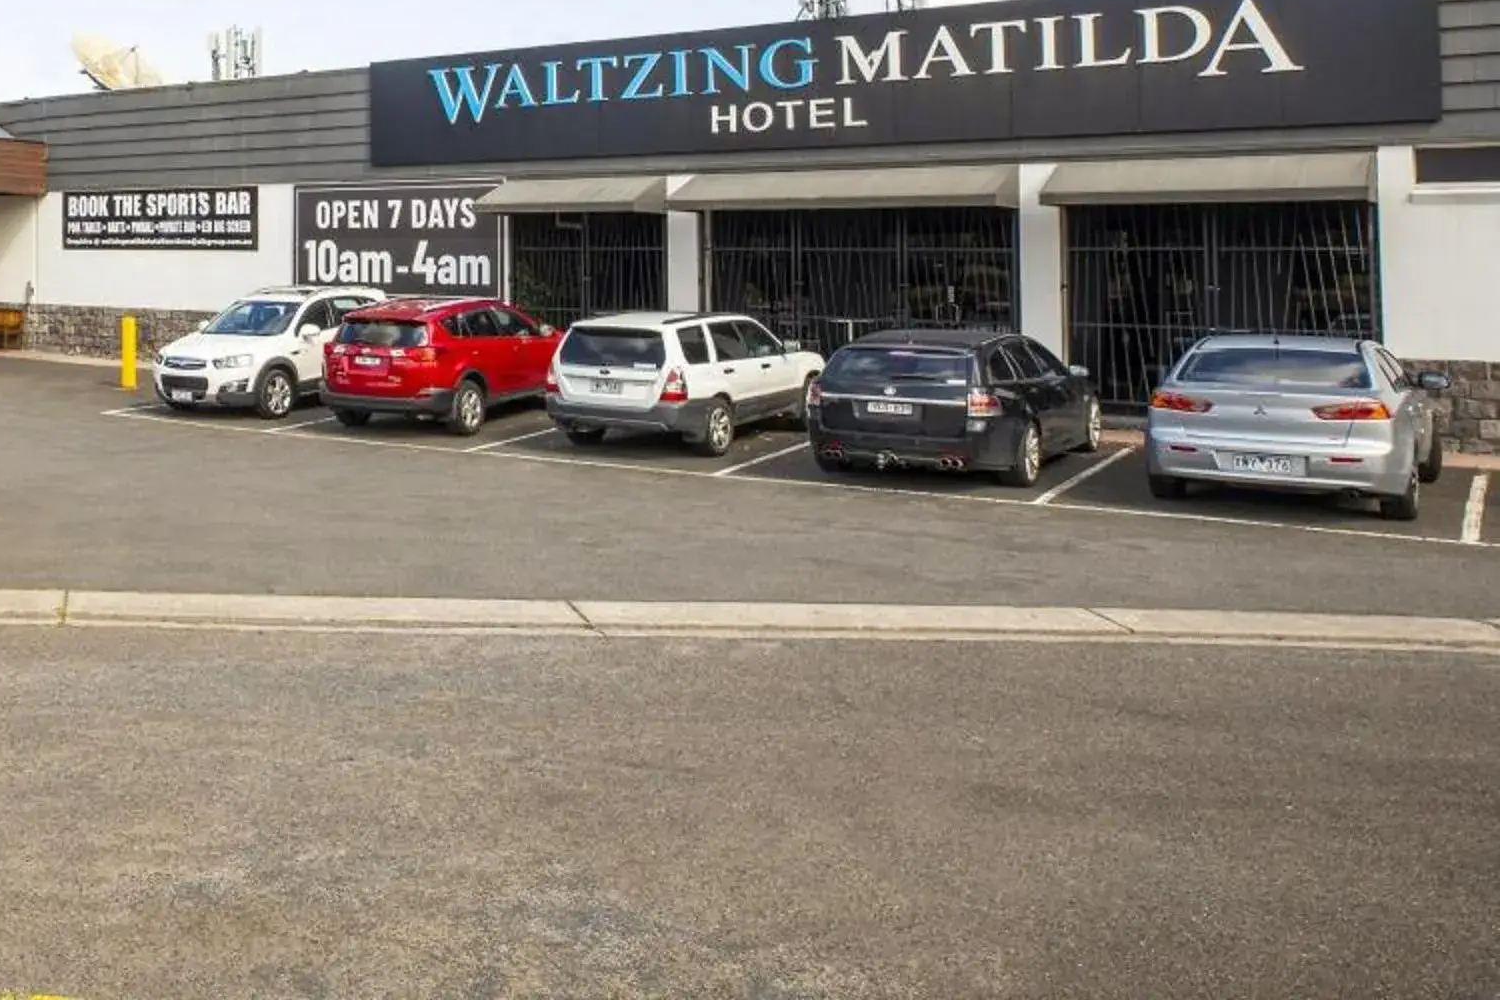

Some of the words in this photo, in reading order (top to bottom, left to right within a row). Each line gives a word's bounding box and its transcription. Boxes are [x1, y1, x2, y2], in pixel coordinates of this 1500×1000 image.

[427, 37, 820, 125] WALTZING
[710, 97, 869, 134] HOTEL
[67, 195, 109, 217] BOOK
[112, 193, 142, 217] THE
[146, 191, 210, 217] SPORTS
[215, 191, 251, 215] BAR
[315, 200, 379, 229] OPEN
[387, 200, 402, 229] 7
[411, 197, 477, 229] DAYS
